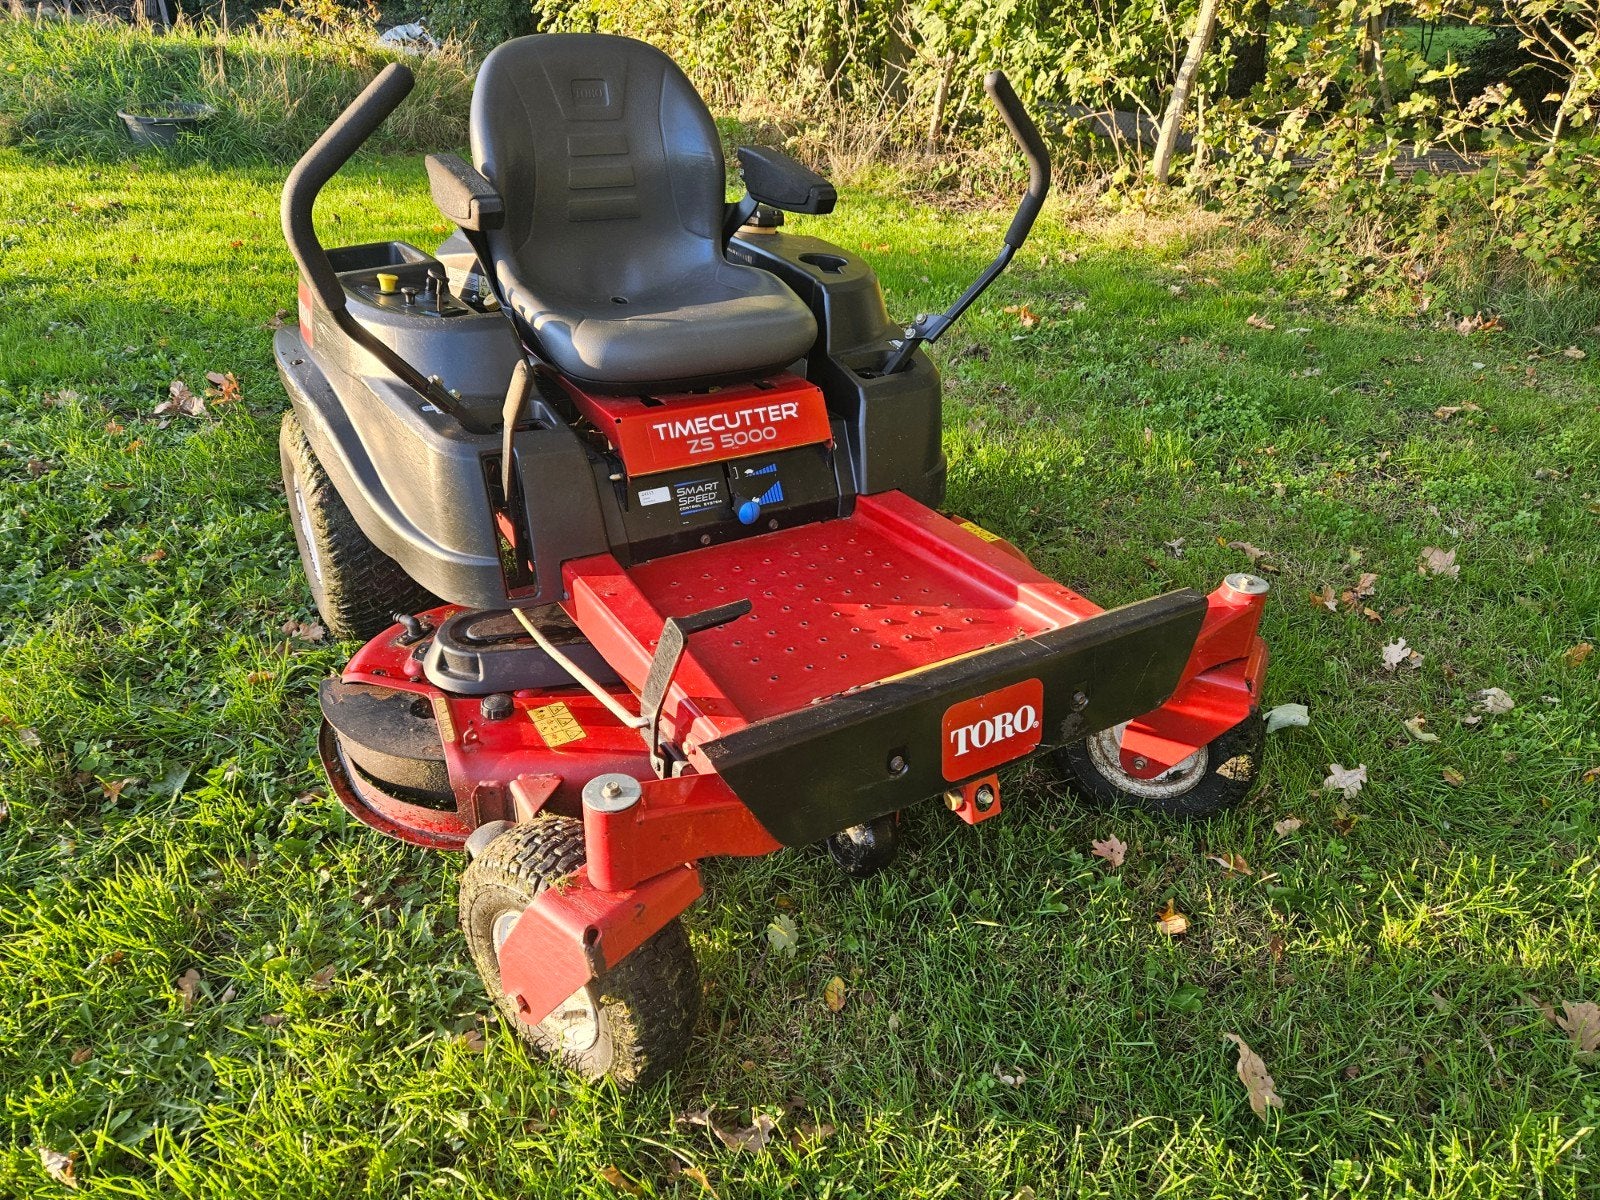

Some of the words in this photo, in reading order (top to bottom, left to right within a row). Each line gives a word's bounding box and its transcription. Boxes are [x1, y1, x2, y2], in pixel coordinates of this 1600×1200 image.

[575, 88, 603, 99] TORO
[687, 437, 715, 454] ZS
[720, 426, 777, 449] 5000
[676, 481, 719, 497] SMART
